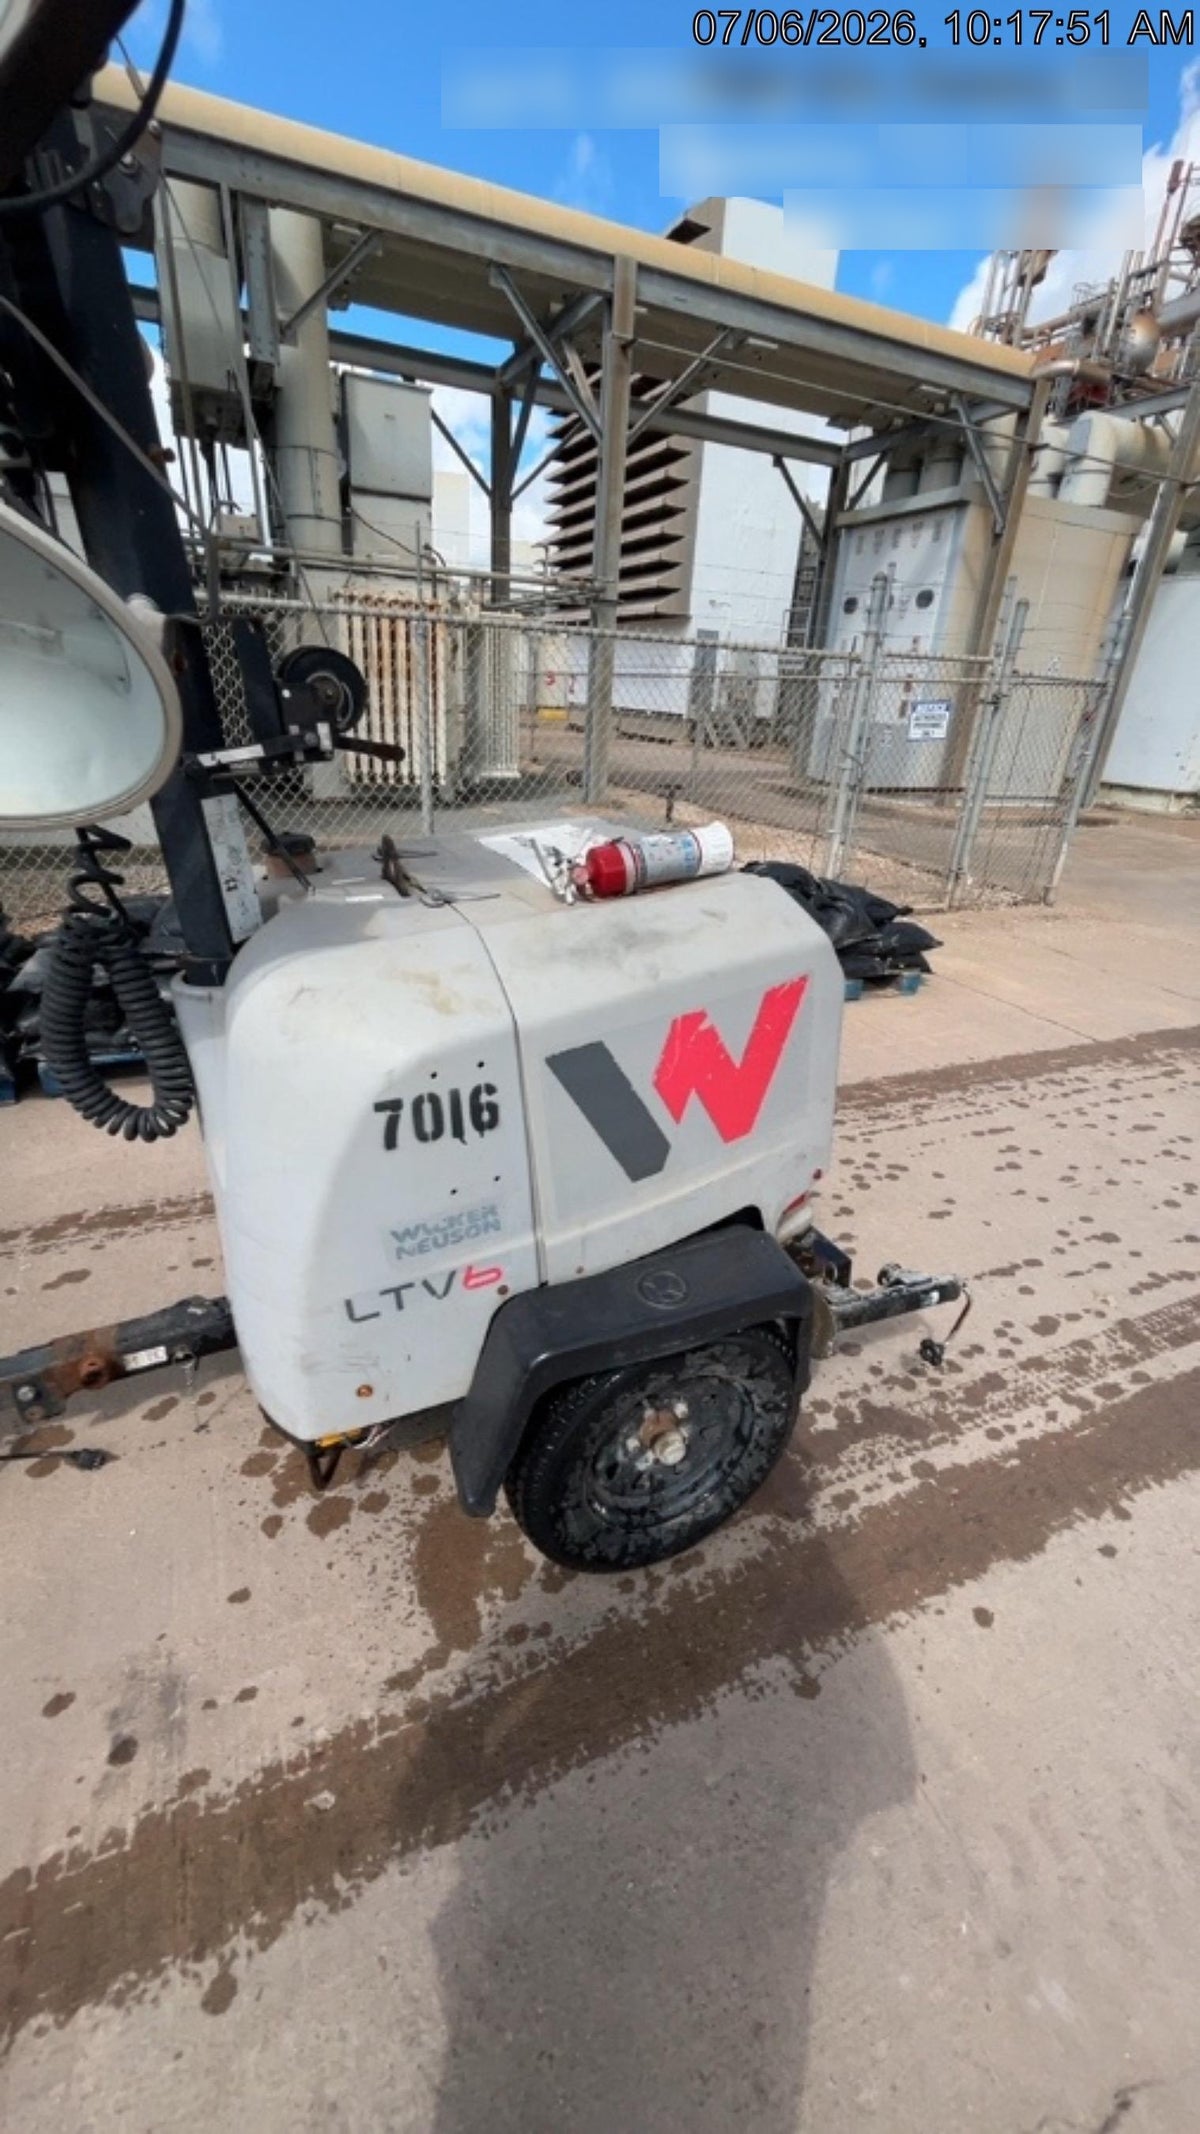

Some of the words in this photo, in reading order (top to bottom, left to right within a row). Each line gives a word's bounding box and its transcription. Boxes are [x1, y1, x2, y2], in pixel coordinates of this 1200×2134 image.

[373, 1083, 499, 1151] 7016
[396, 1219, 501, 1260] NEUSON
[345, 1265, 503, 1323] LTV6
